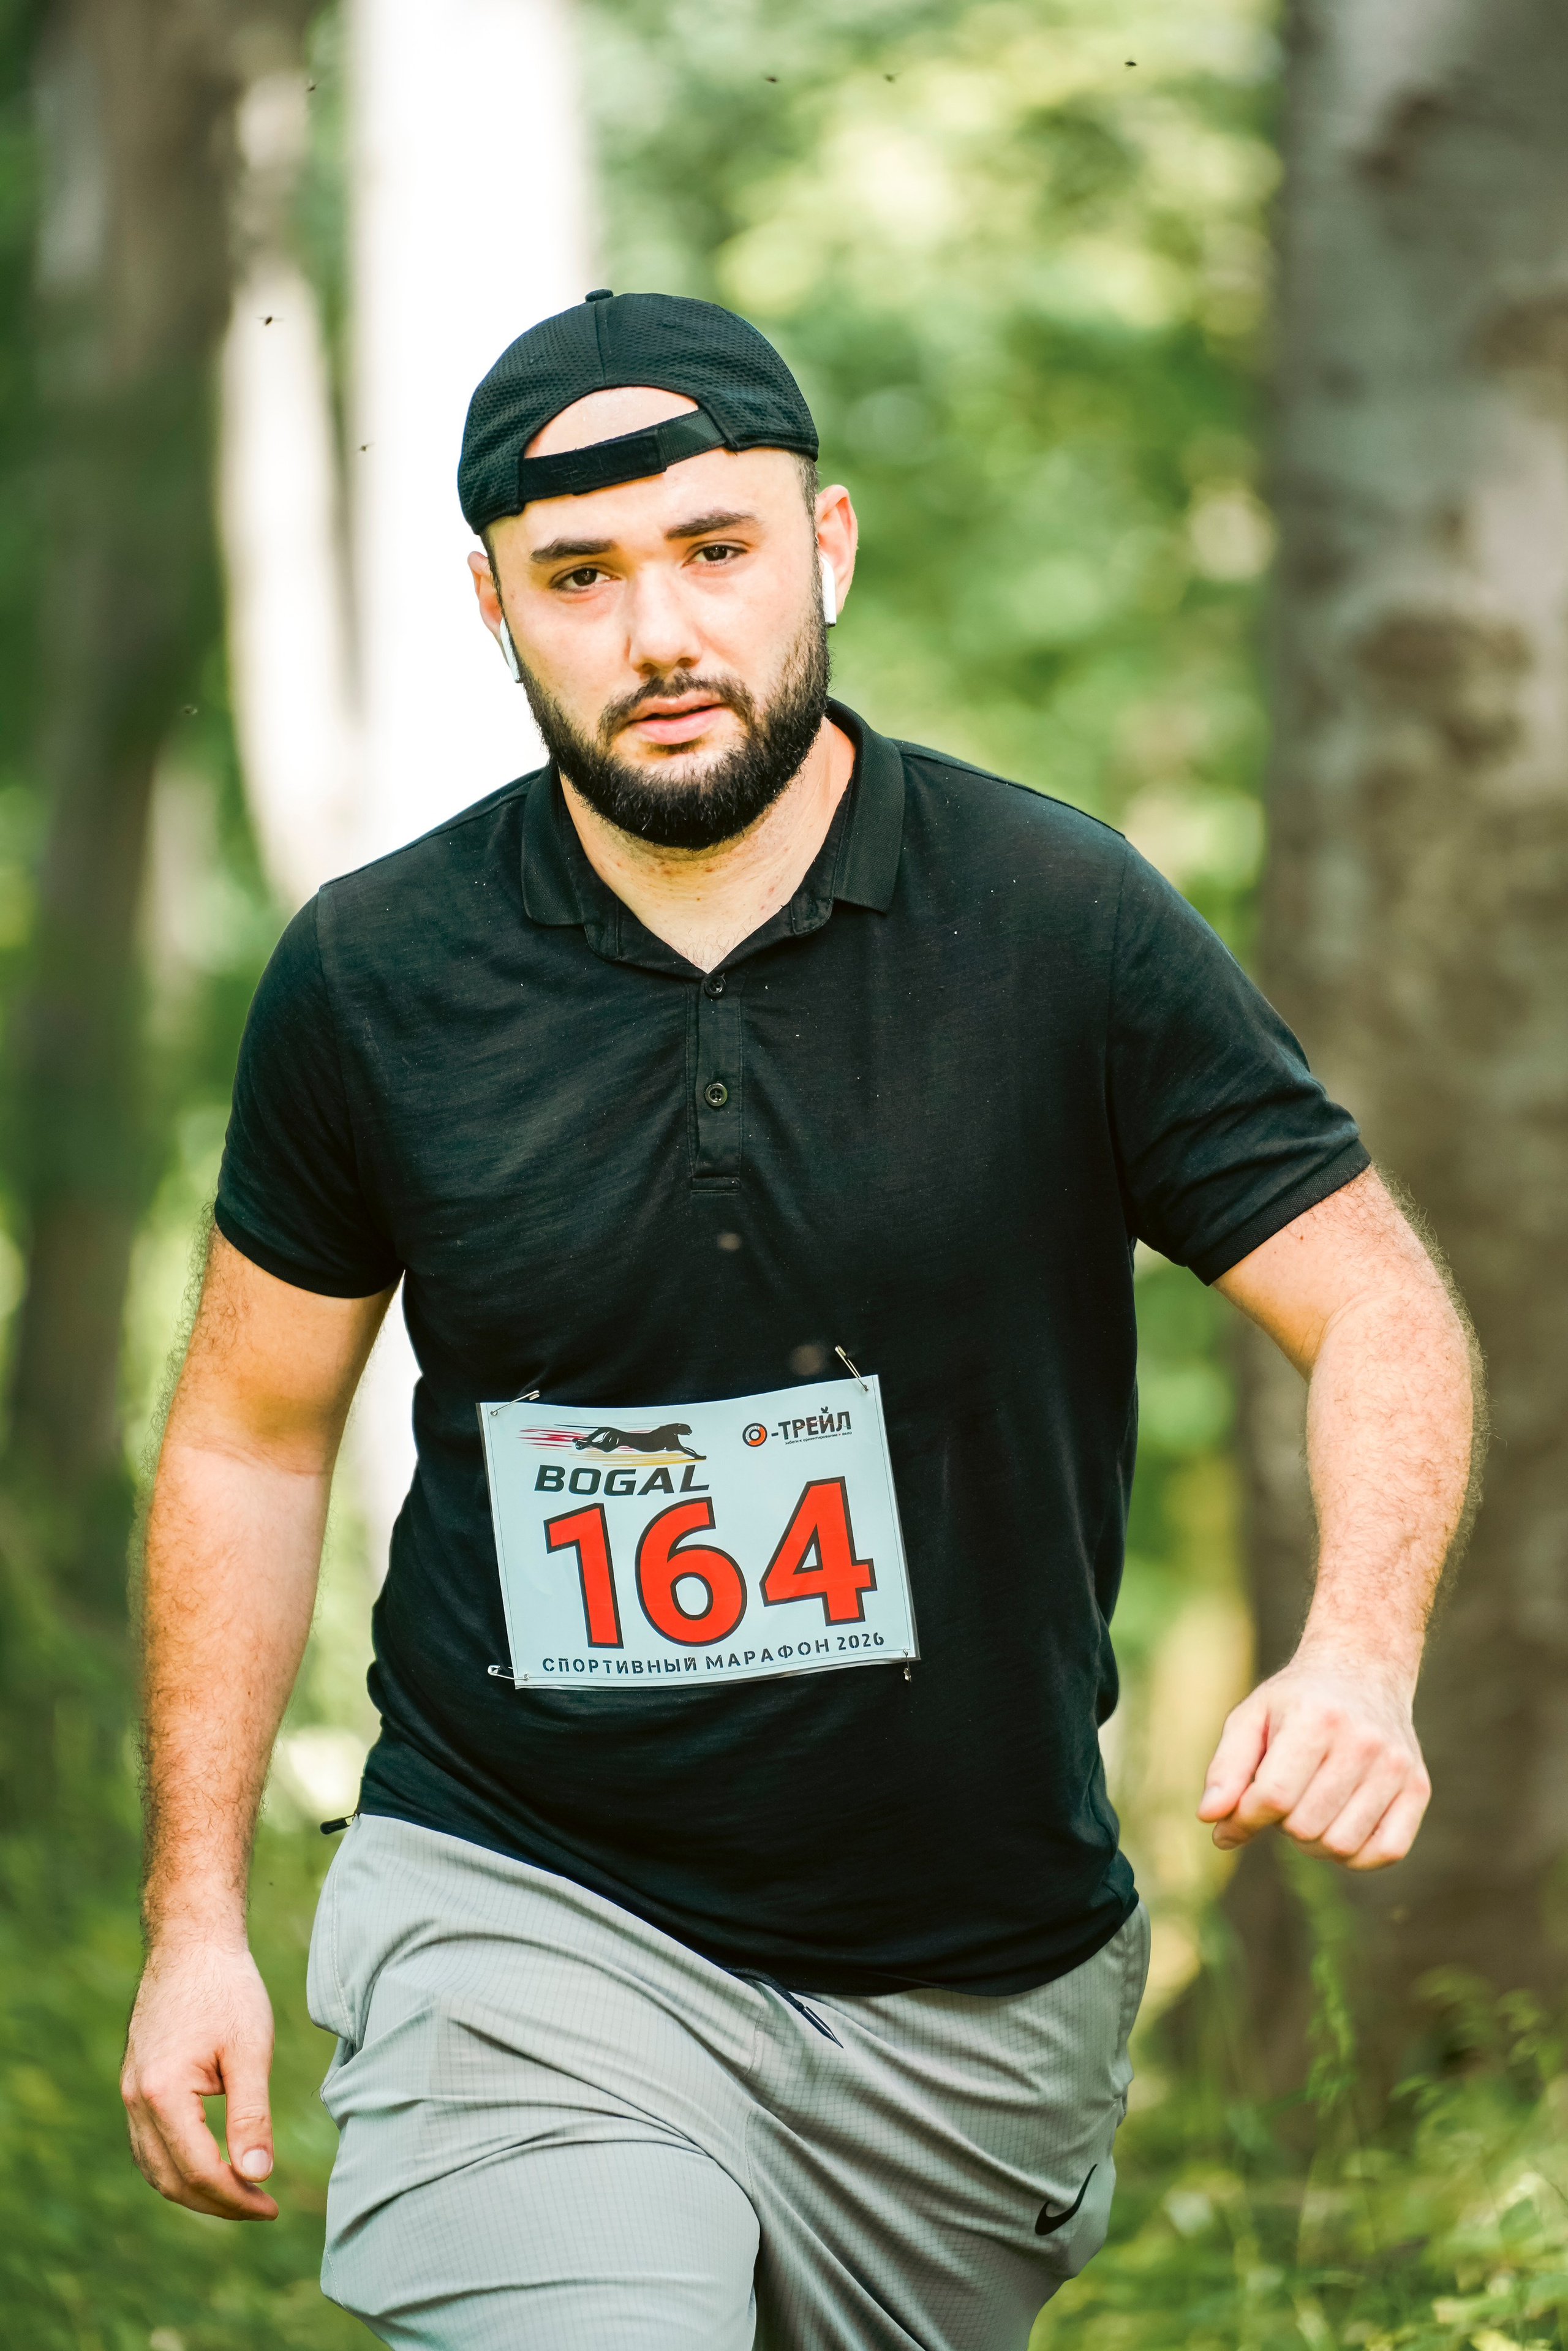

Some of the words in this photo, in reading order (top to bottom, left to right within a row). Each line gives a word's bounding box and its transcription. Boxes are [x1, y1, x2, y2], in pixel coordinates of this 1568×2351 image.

[534, 1465, 710, 1496] BOGAL
[543, 1476, 878, 1649] 164
[541, 1657, 698, 1674] СПОРТИВНЫЙ
[705, 1638, 829, 1669] МАРАФОН
[837, 1632, 884, 1650] 2026
